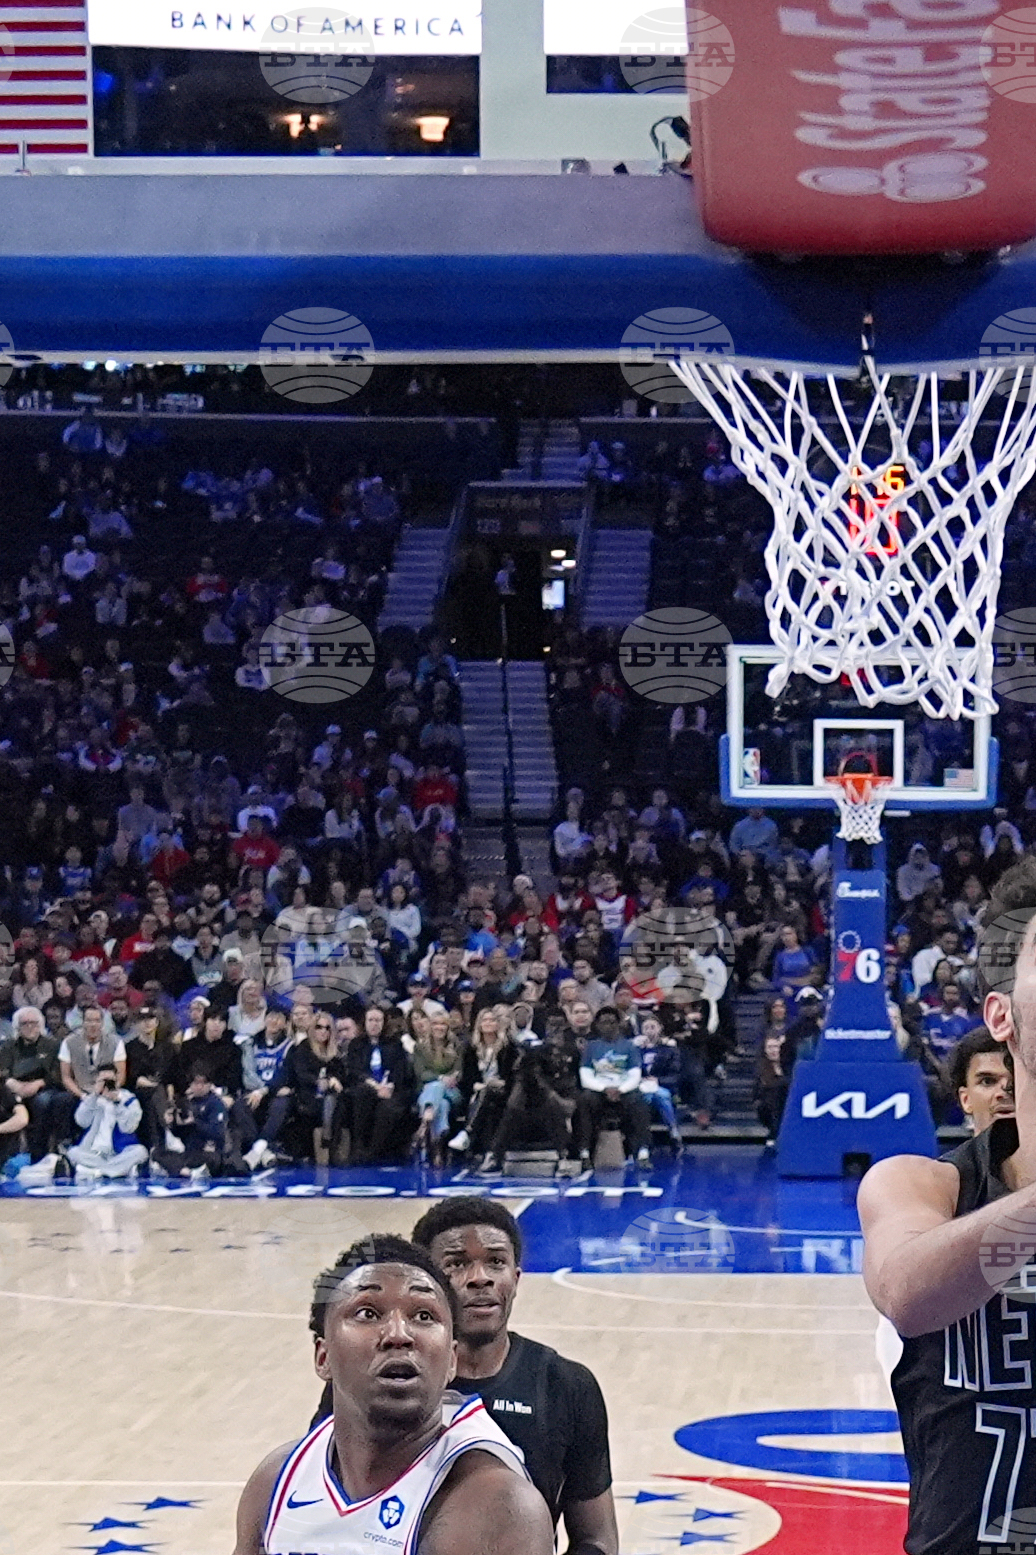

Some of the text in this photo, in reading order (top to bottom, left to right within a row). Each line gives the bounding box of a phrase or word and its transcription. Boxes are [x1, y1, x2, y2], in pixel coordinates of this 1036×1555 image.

[171, 10, 465, 37] BANK OF AMERICA
[838, 948, 882, 983] 76
[801, 1091, 910, 1119] KIA
